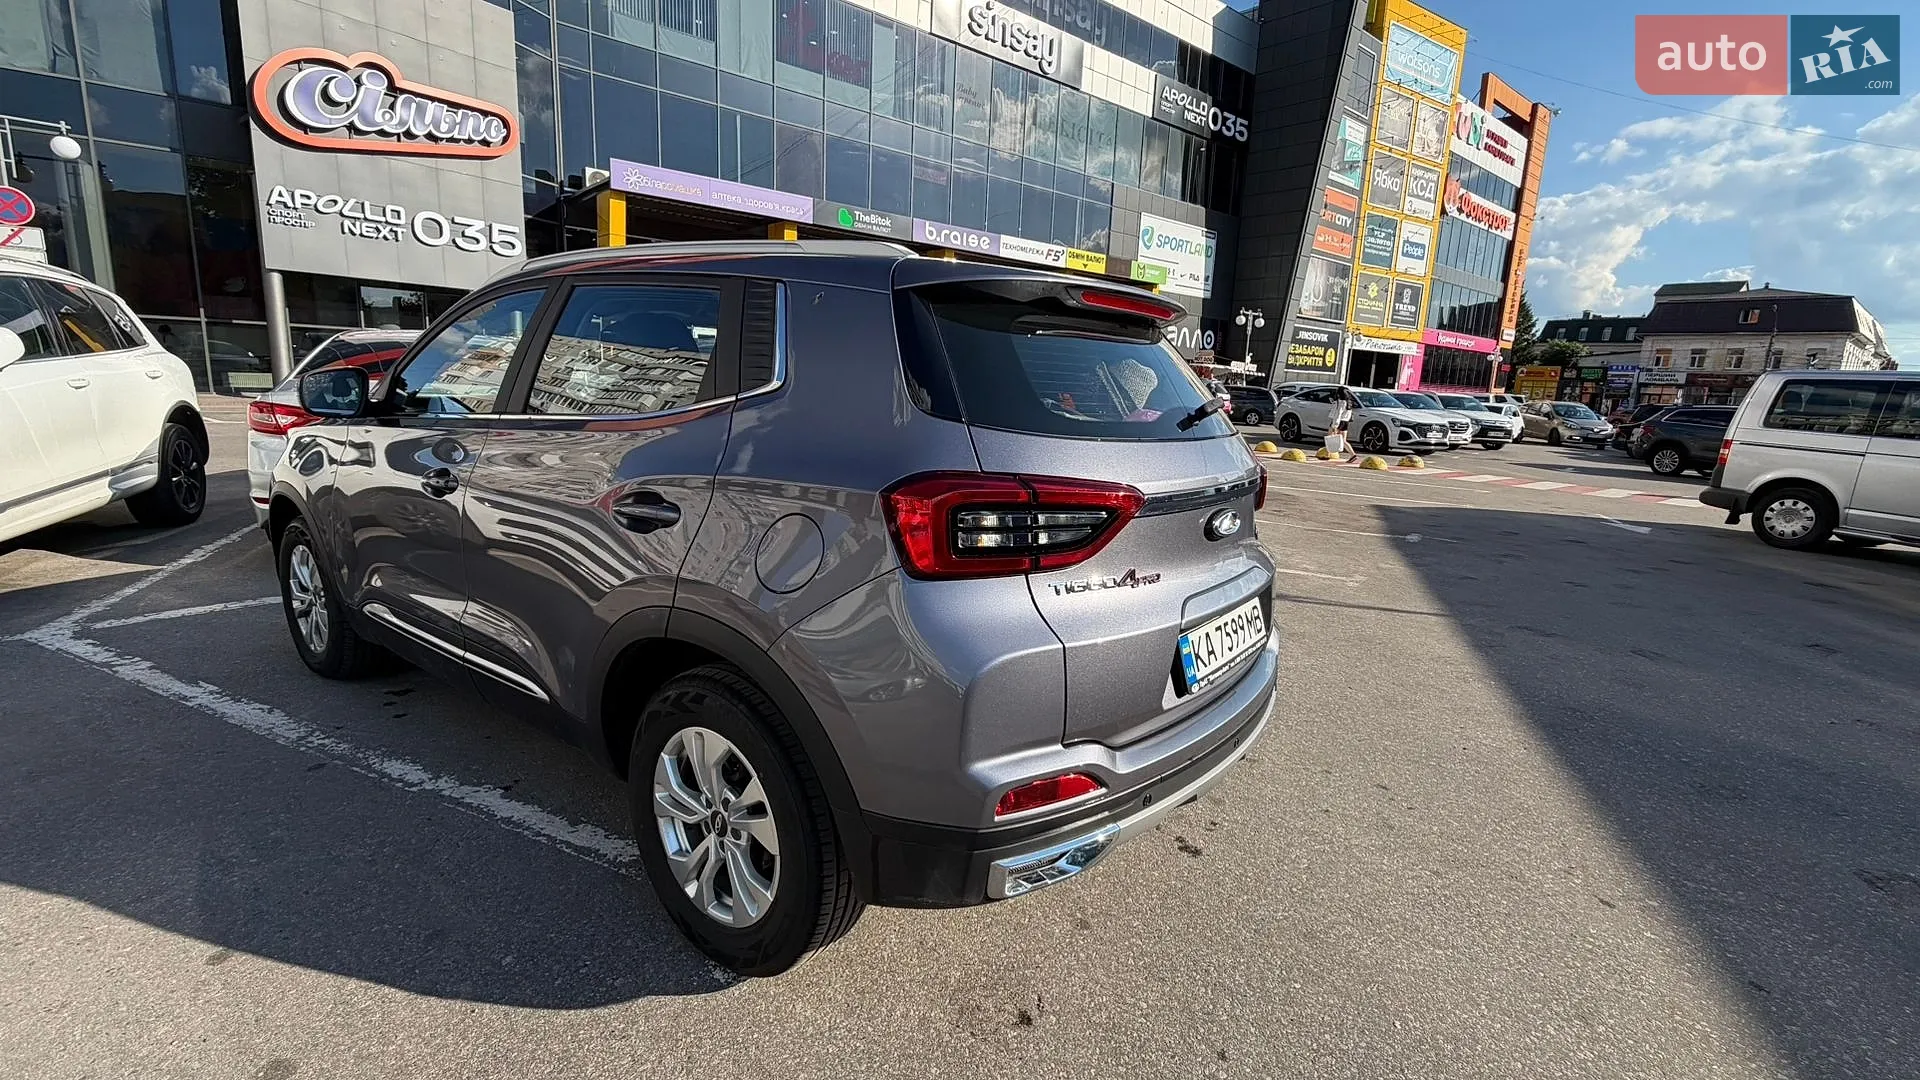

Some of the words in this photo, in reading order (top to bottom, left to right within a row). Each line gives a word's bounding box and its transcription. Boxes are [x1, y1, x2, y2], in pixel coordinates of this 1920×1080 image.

[969, 0, 1058, 75] sinsay
[1399, 52, 1440, 78] watsons
[285, 67, 507, 142] Сільпо
[1162, 86, 1208, 116] APOLLO
[1184, 110, 1207, 126] NEXT
[1208, 107, 1248, 141] 035
[1373, 168, 1401, 192] Ябко
[1409, 177, 1436, 201] КСД
[268, 185, 406, 225] APOLLO
[269, 208, 306, 220] СПОРТ
[854, 210, 892, 227] TheBitok
[343, 220, 407, 241] NEXT
[412, 210, 522, 257] 035
[925, 221, 991, 250] b.raise
[1156, 233, 1213, 259] SPORTLAND
[1002, 241, 1045, 257] ТЕХНОМЕРЕЖА
[1068, 250, 1086, 261] ОБМІН
[1086, 253, 1105, 264] ВАЛЮТ
[1403, 243, 1425, 257] People
[1191, 631, 1218, 673] KA
[1214, 614, 1246, 658] 7599
[1245, 605, 1263, 640] MB
